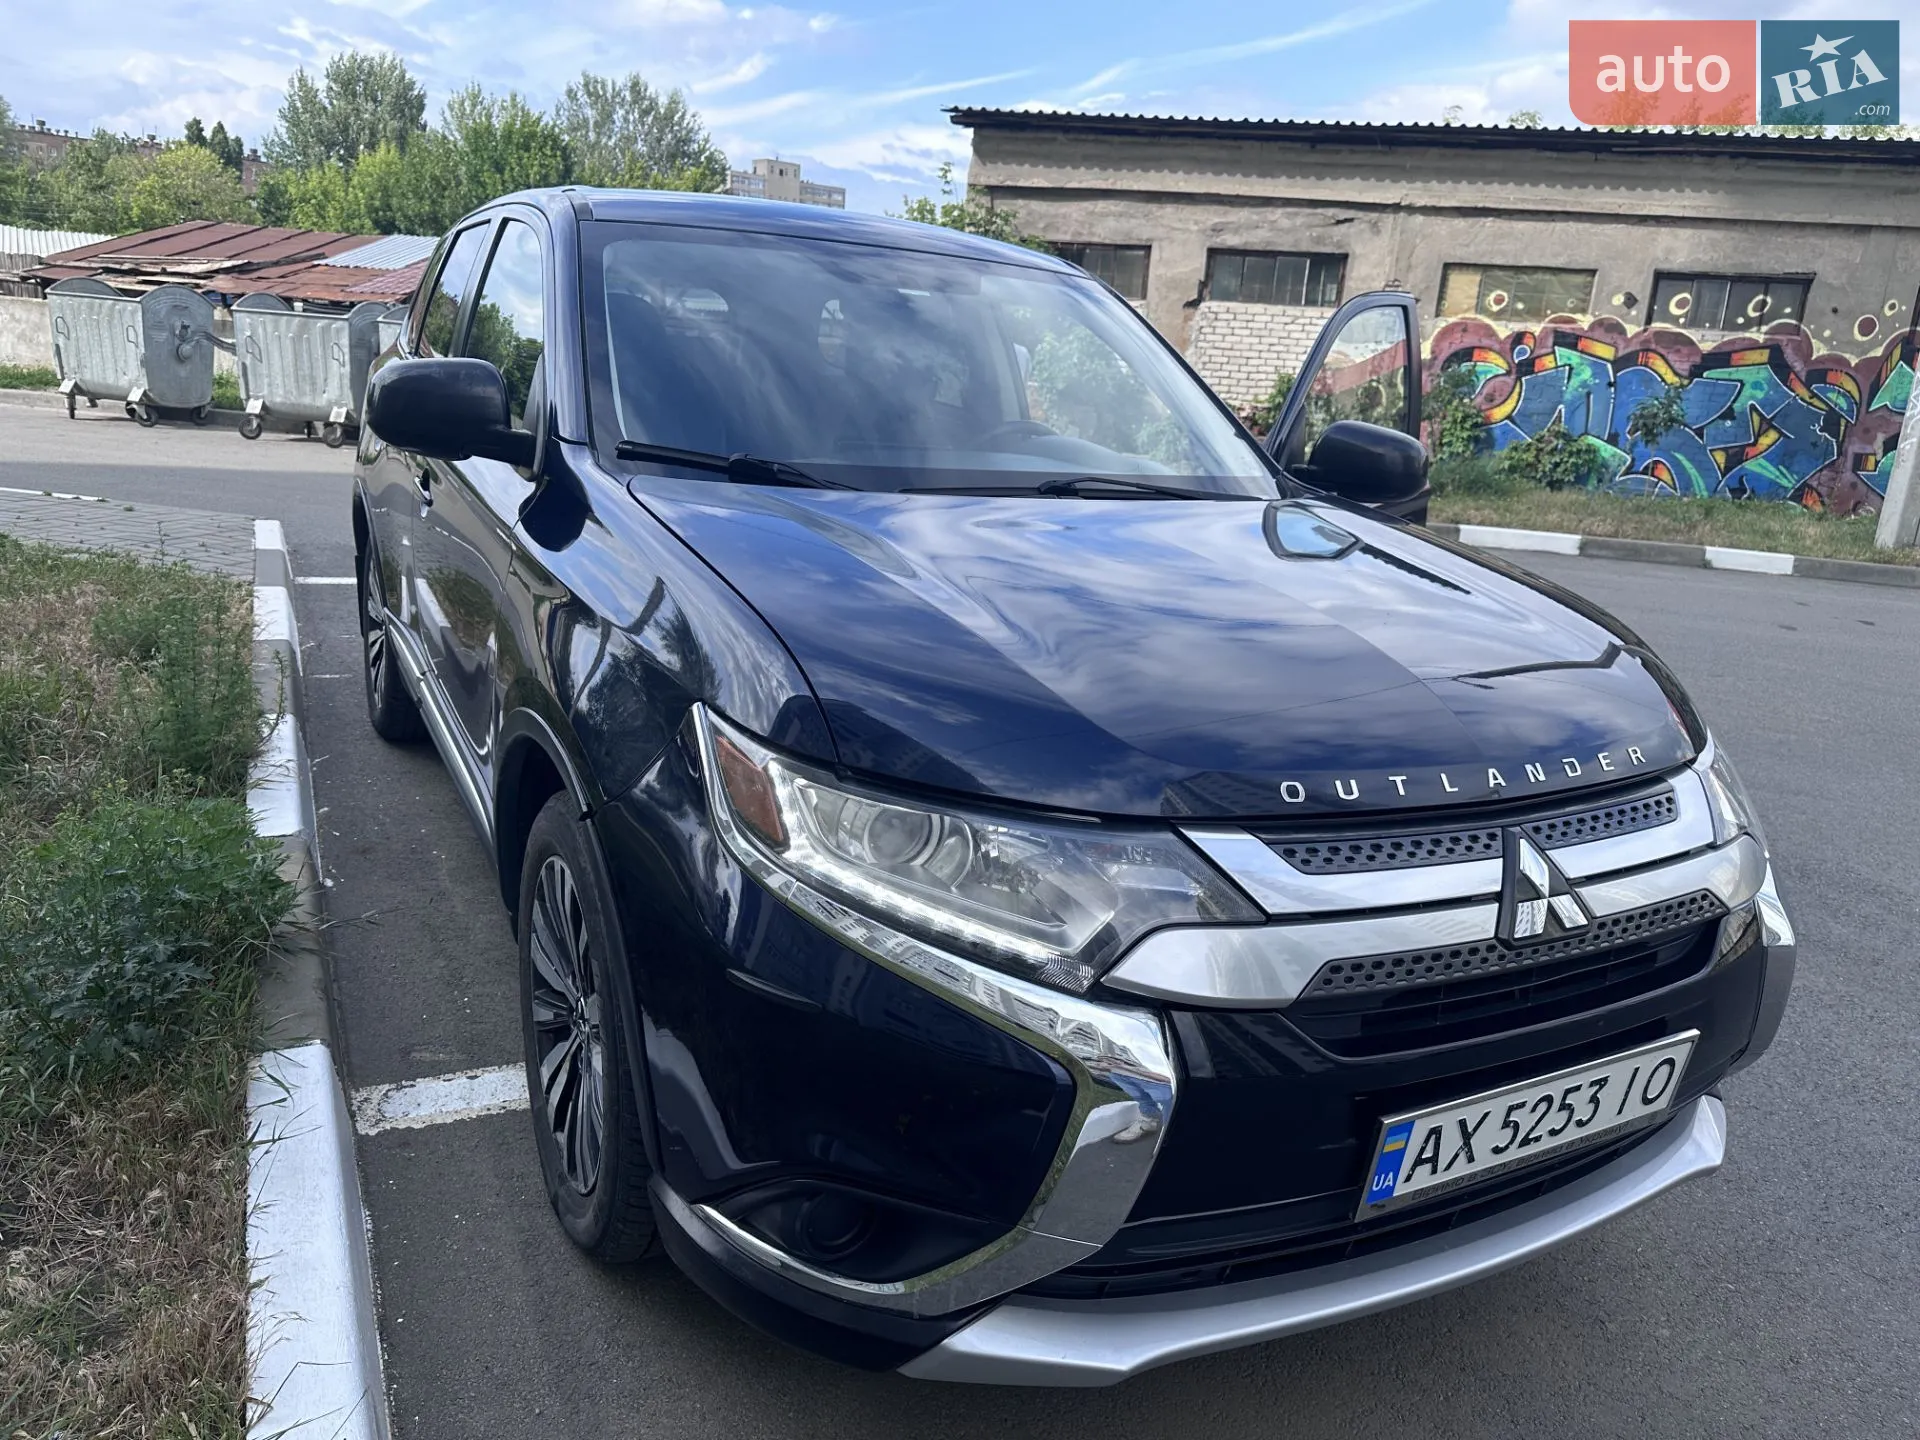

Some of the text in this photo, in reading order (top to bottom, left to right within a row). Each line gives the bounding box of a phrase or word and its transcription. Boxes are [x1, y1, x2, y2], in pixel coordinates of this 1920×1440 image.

[1280, 745, 1646, 804] OUTLANDER
[1403, 1109, 1492, 1184] AX
[1490, 1074, 1611, 1155] 5253
[1372, 1171, 1394, 1191] UA
